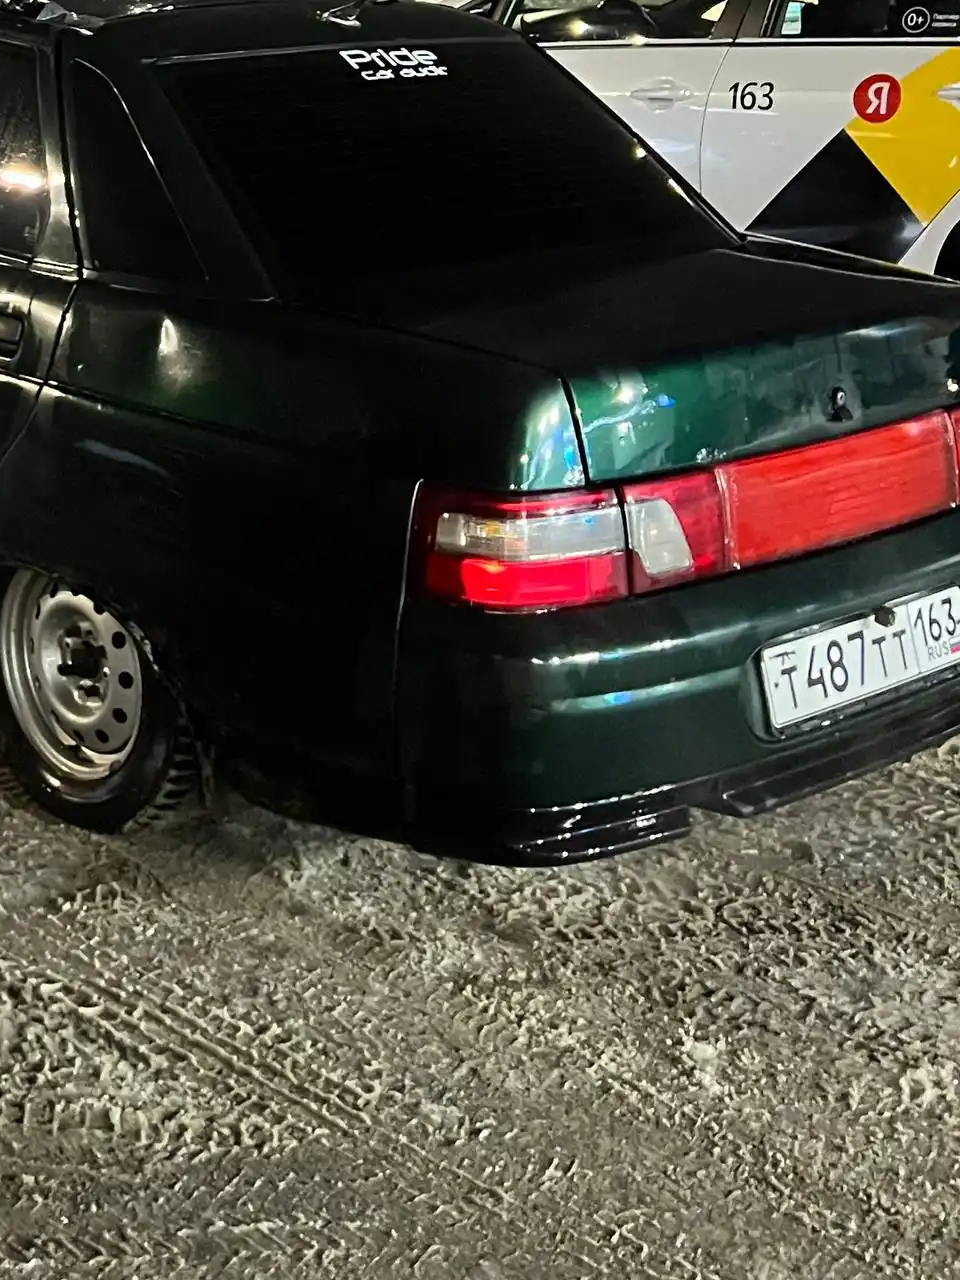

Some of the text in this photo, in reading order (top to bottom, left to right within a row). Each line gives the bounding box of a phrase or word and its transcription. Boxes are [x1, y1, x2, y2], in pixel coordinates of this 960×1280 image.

[339, 47, 438, 69] Pride
[728, 81, 775, 111] 163
[866, 81, 890, 115] Я
[914, 597, 957, 648] 163
[928, 640, 951, 662] RUS
